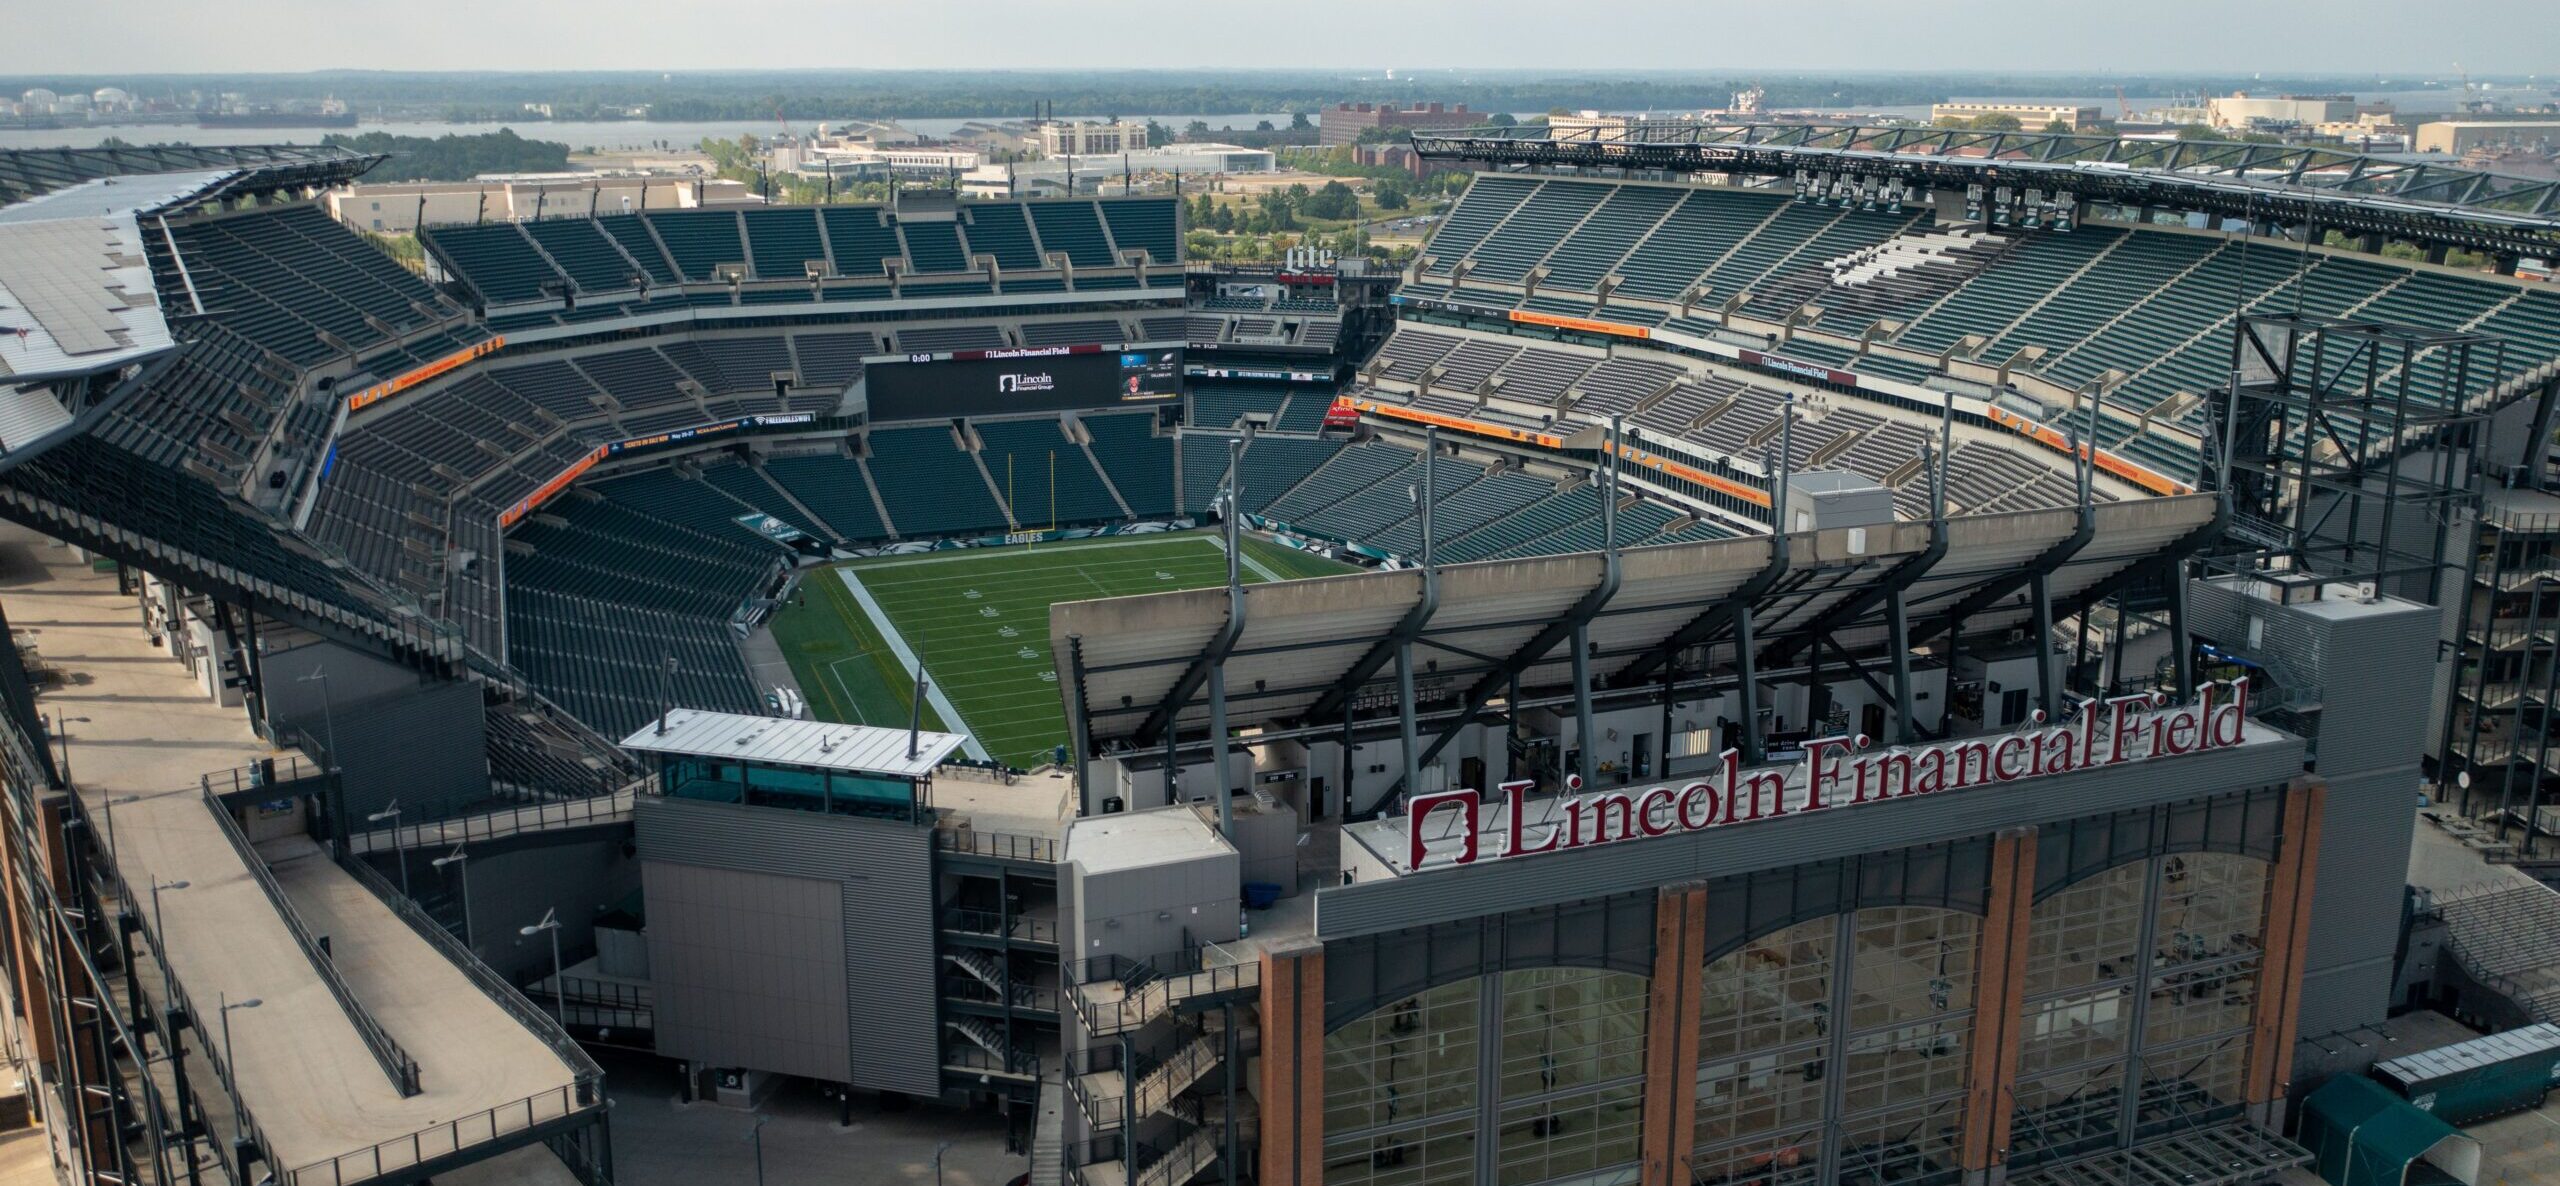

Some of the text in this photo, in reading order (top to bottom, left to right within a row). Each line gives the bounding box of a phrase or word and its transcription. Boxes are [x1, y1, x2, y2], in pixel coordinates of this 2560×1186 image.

[994, 346, 1070, 358] Lincoln Financial Field
[912, 354, 930, 363] 0:00
[1768, 358, 1828, 380] Lincoln Financial Field
[1016, 372, 1052, 384] Lincoln
[1004, 532, 1044, 545] EAGLES
[1498, 675, 2249, 858] Lincoln Financial Field
